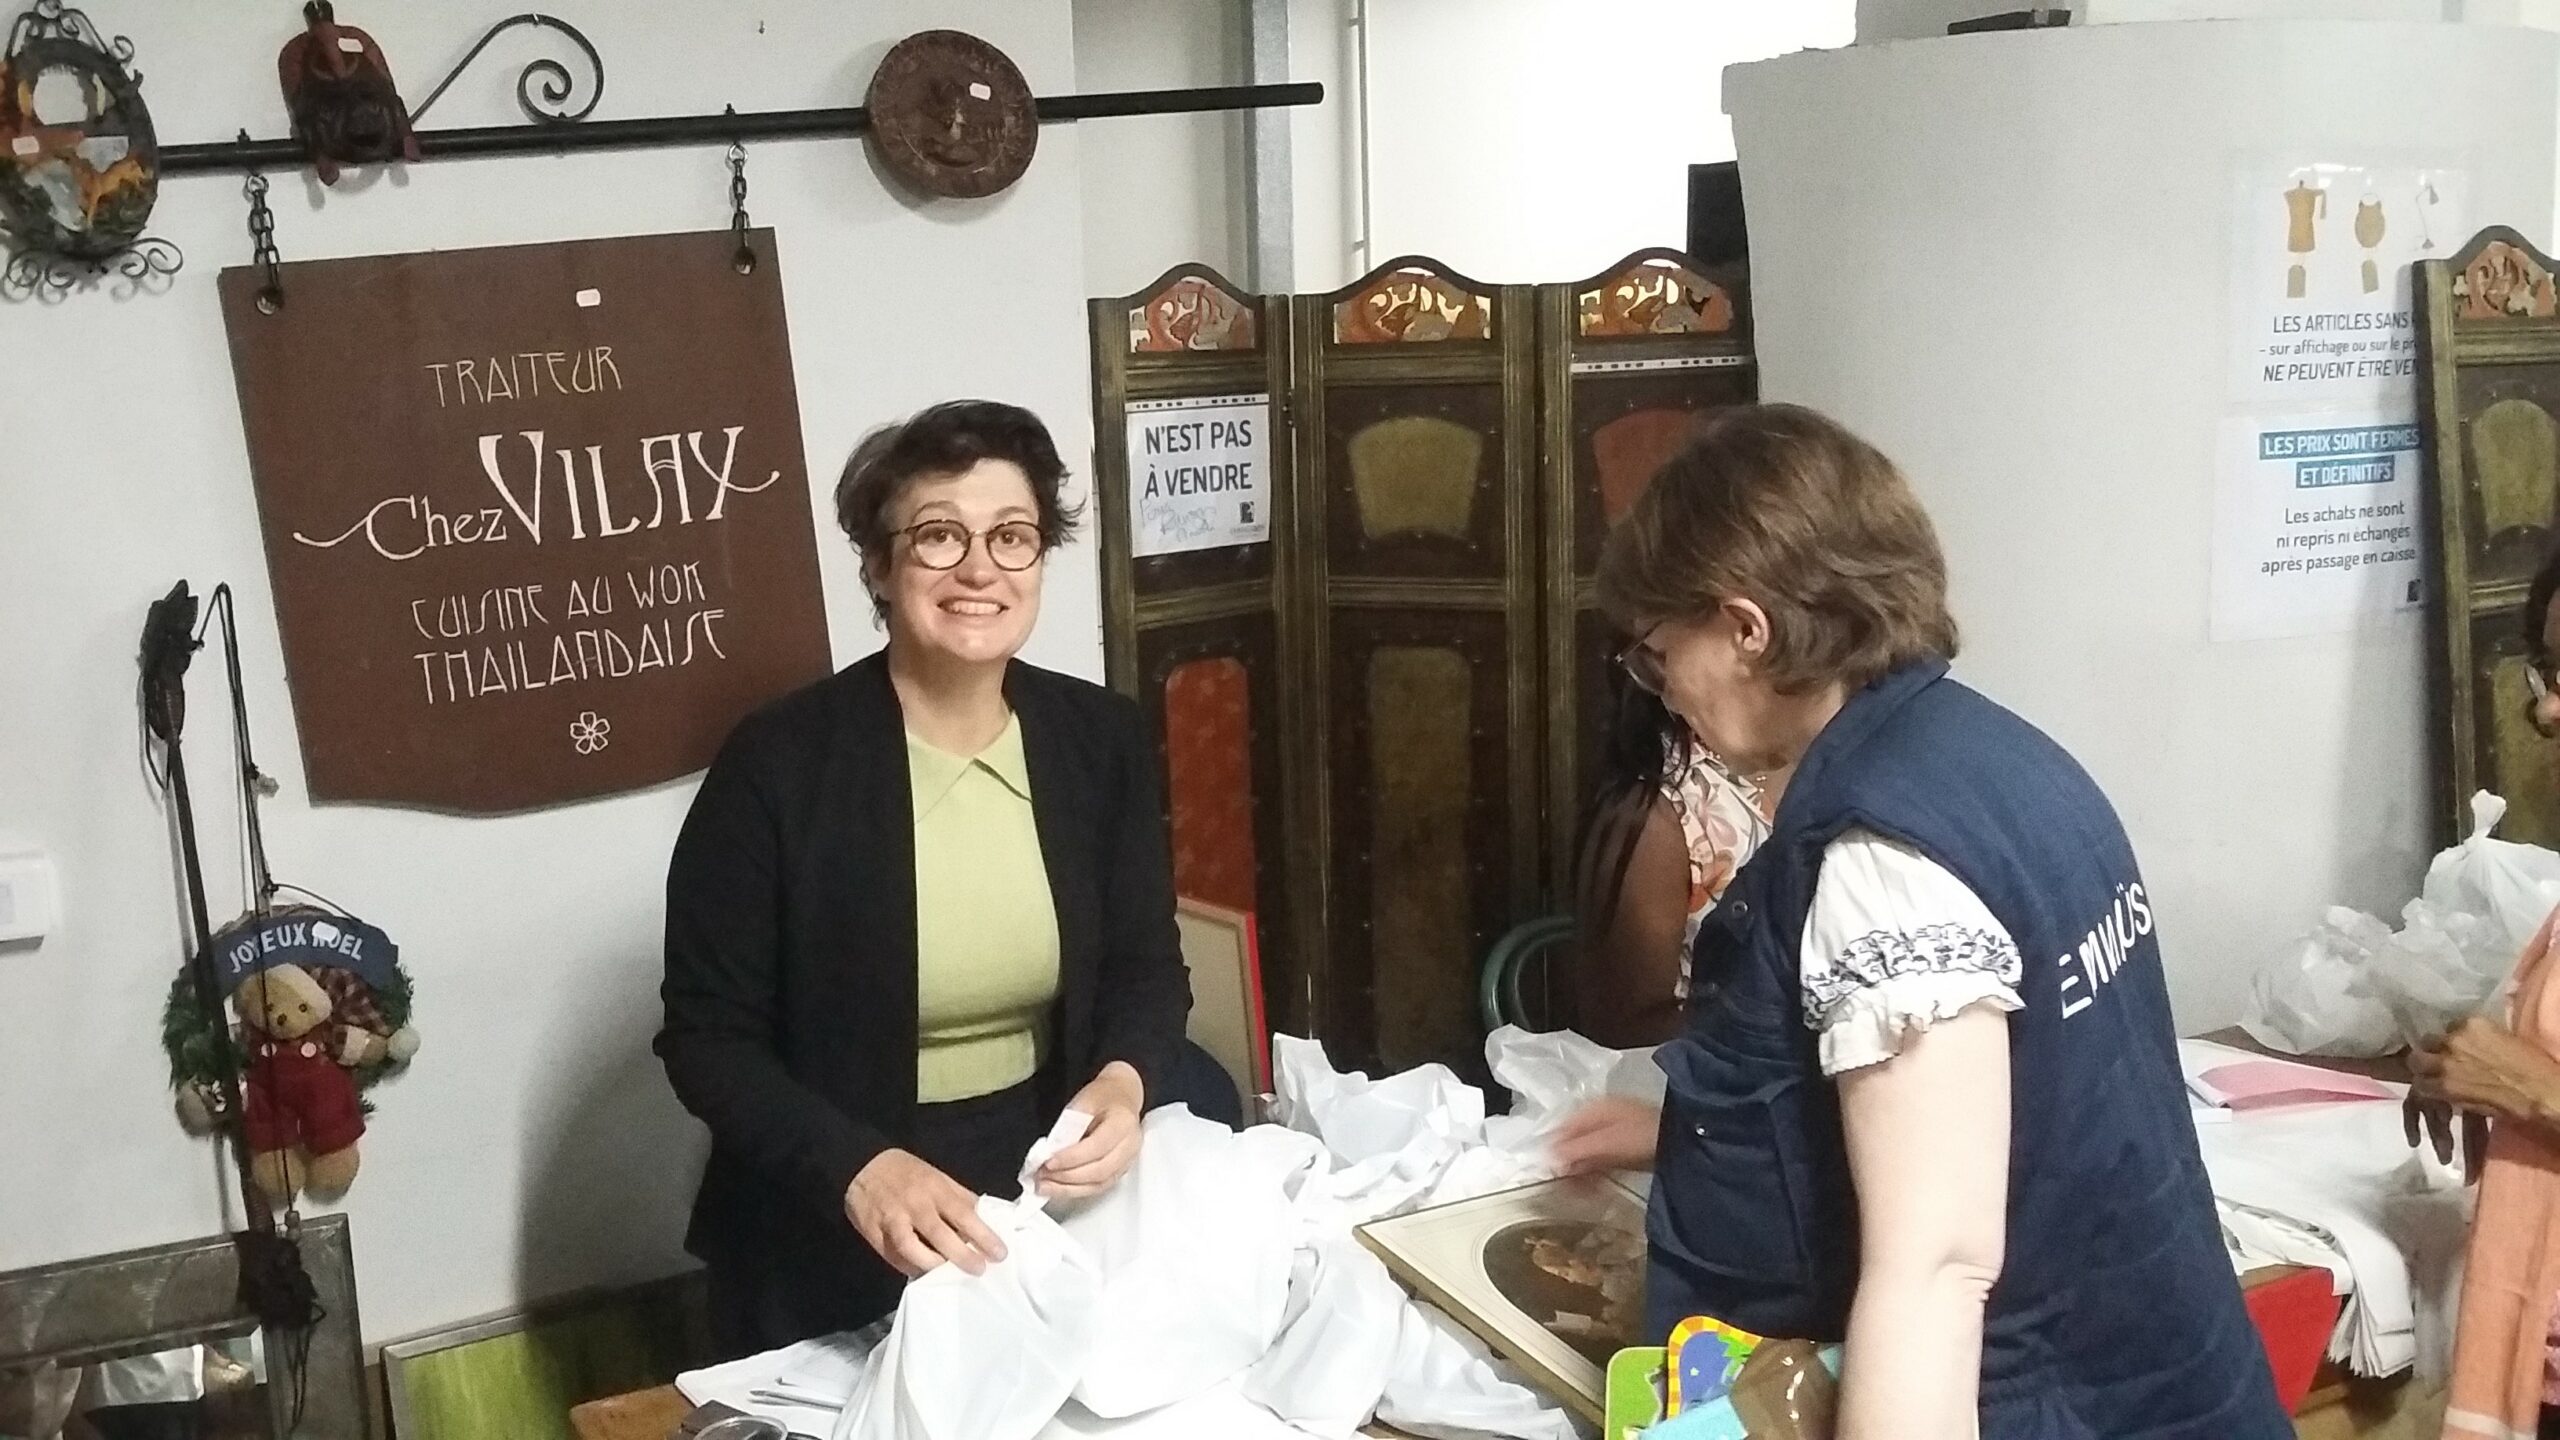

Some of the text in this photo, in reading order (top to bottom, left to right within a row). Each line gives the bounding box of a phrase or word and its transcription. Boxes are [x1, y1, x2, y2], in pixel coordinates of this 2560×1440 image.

[2273, 311, 2409, 334] LES ARTICLES SANS
[2269, 344, 2290, 356] sur
[2294, 337, 2349, 357] affichage
[2352, 341, 2367, 352] ou
[2370, 340, 2388, 351] sur
[2390, 335, 2401, 350] le
[424, 345, 623, 408] TRAITEUR
[2263, 363, 2285, 382] NE
[2288, 361, 2356, 381] PEUVENT
[2357, 356, 2393, 378] ÊTRE
[1145, 420, 1252, 455] N'EST PAS
[2264, 436, 2294, 456] LES
[2297, 434, 2331, 454] PRIX
[2333, 431, 2369, 452] SONT
[1144, 462, 1253, 500] À VENDRE
[2300, 461, 2392, 486] ET DÉFINITIFS
[293, 494, 508, 561] Chez
[2285, 500, 2405, 525] Les achats ne sont
[2276, 524, 2411, 551] ni repris ni échangés
[2261, 547, 2416, 577] après passage en caisse
[411, 560, 707, 640] CUISINE AU WOK
[413, 608, 727, 705] THAILANDAISE
[228, 922, 306, 974] JOYEUX
